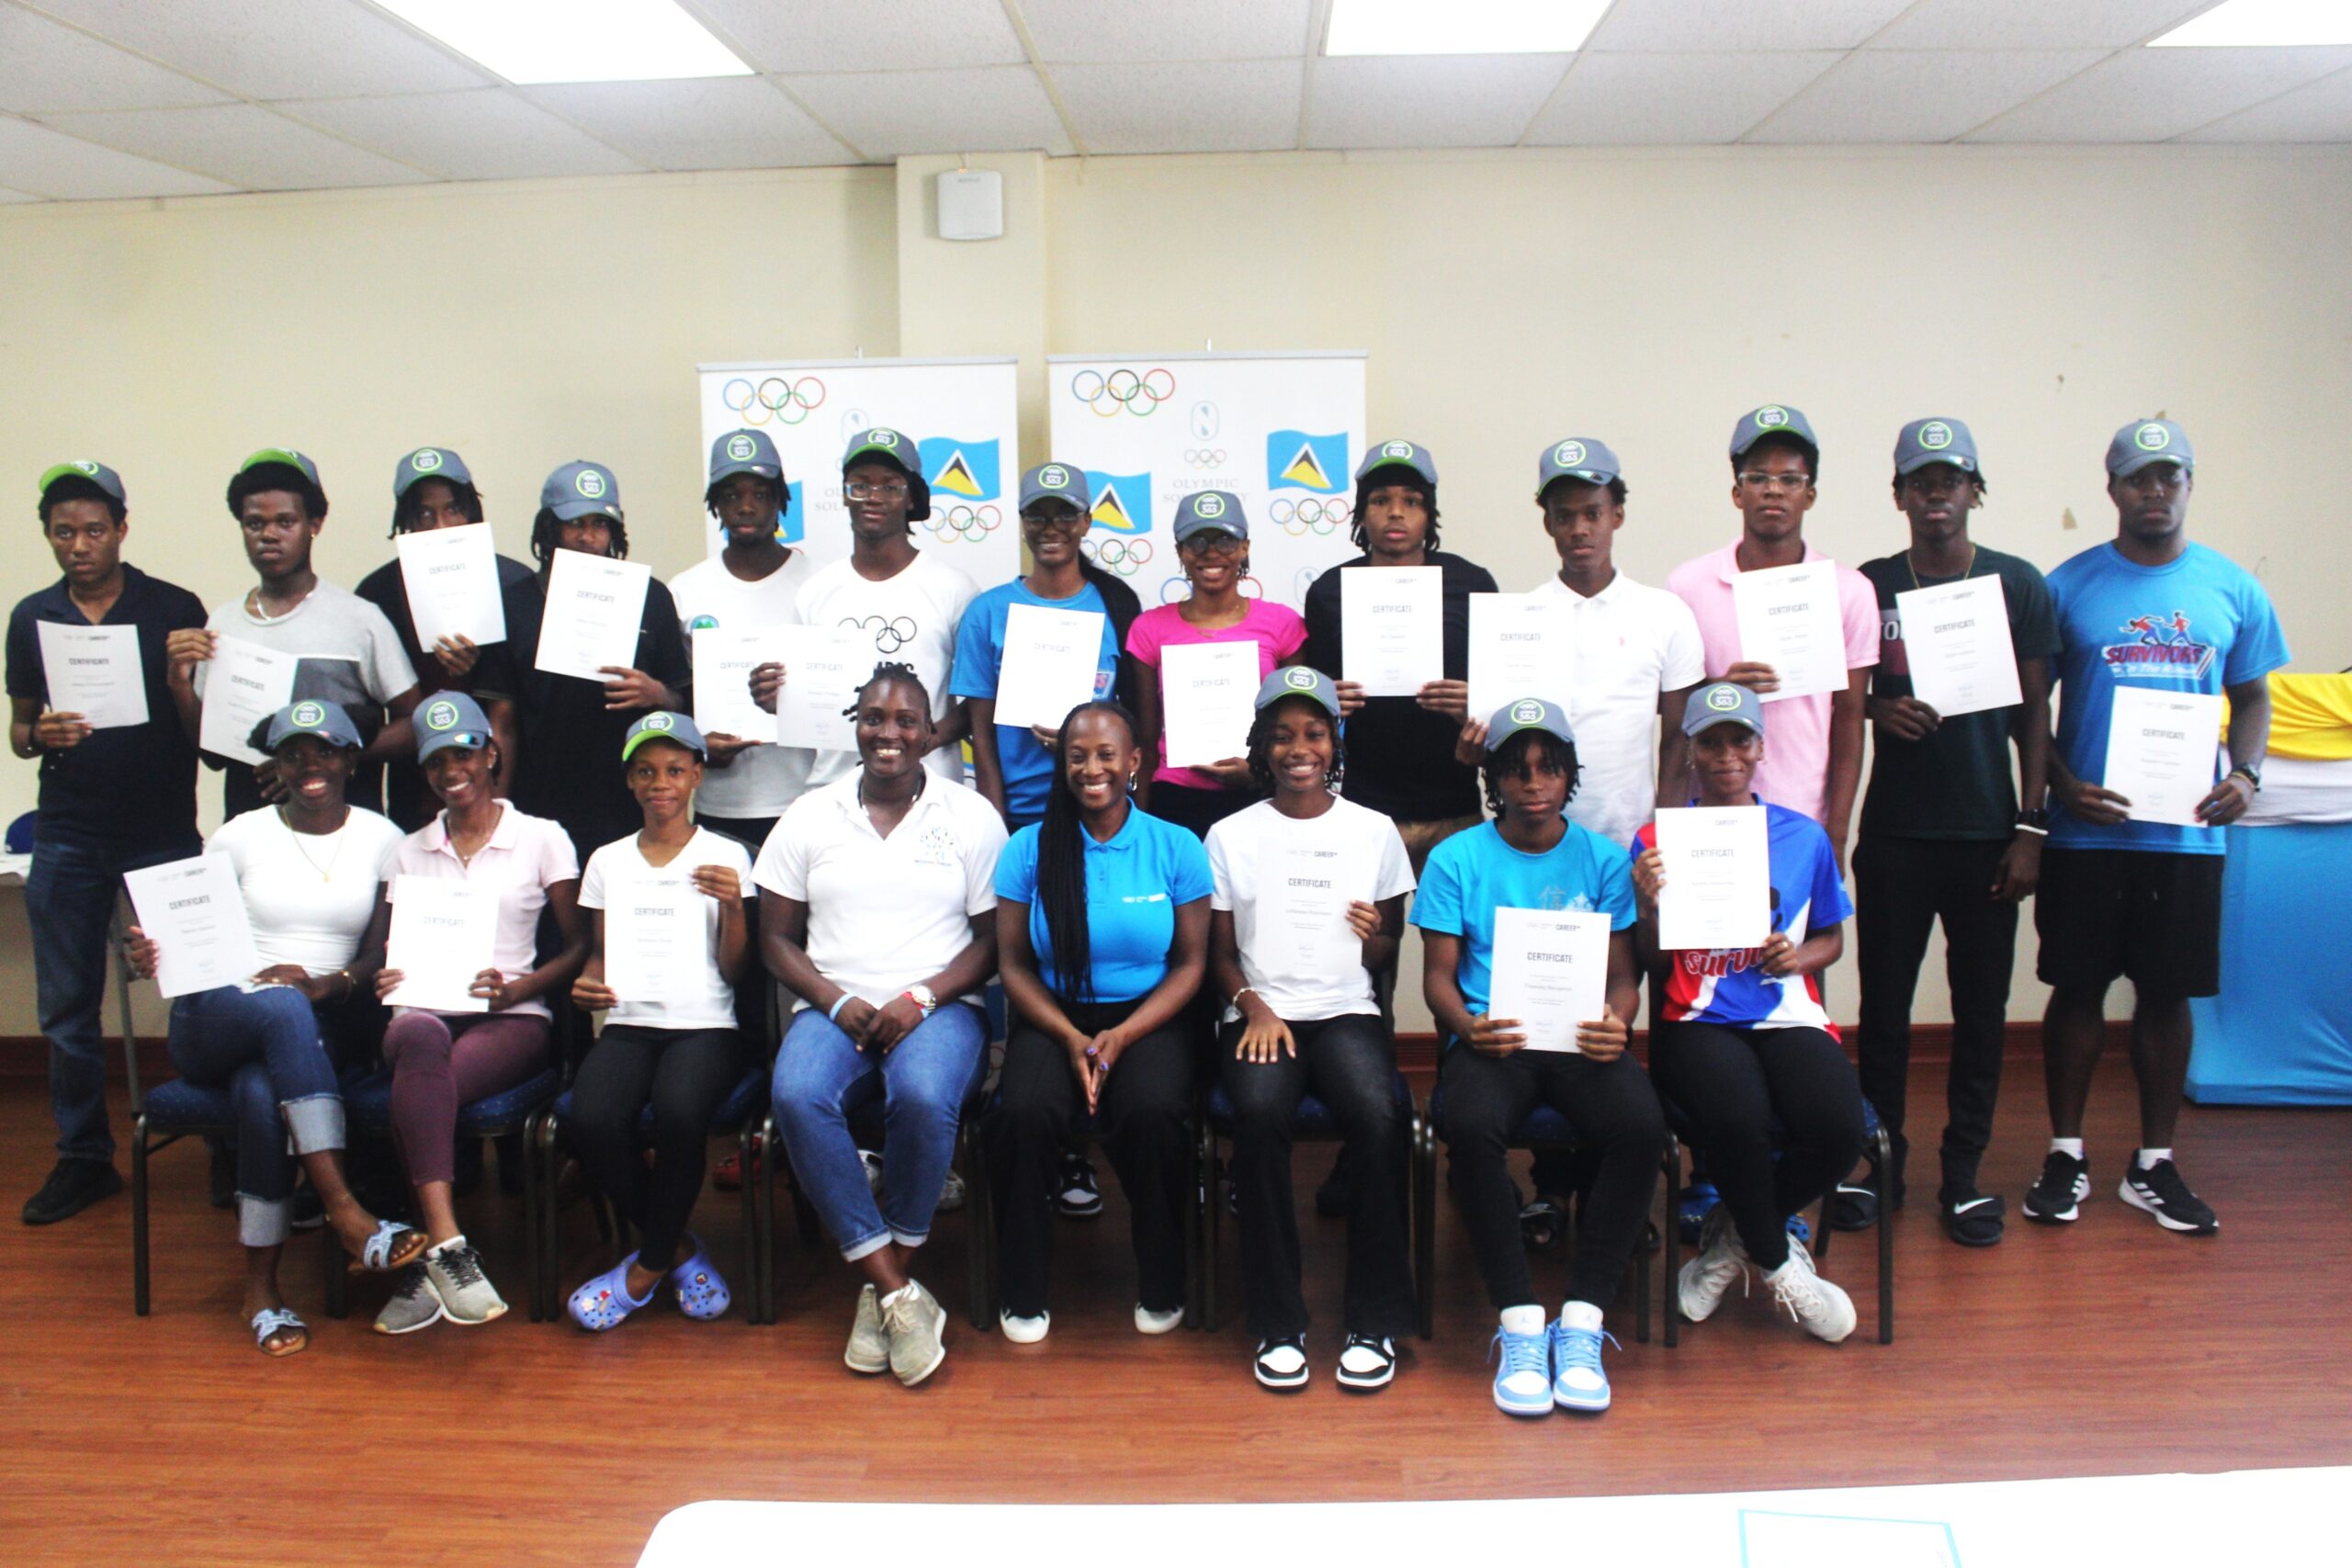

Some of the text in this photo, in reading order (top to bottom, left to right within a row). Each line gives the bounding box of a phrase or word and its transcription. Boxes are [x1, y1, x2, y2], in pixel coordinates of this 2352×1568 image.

[1172, 479, 1240, 489] OLYMPIC
[1373, 604, 1412, 614] CERTIFICATE
[1768, 603, 1809, 615] CERTIFICATE
[1933, 618, 1975, 634] CERTIFICATE
[1499, 632, 1542, 641] CERTIFICATE
[2105, 645, 2203, 665] SURVIVORS
[2142, 728, 2186, 740] CERTIFICATE
[1690, 848, 1735, 858] CERTIFICATE
[1287, 877, 1331, 889] CERTIFICATE
[169, 895, 211, 910] CERTIFICATE
[634, 907, 674, 917] CERTIFICATE
[1526, 951, 1573, 964] CERTIFICATE
